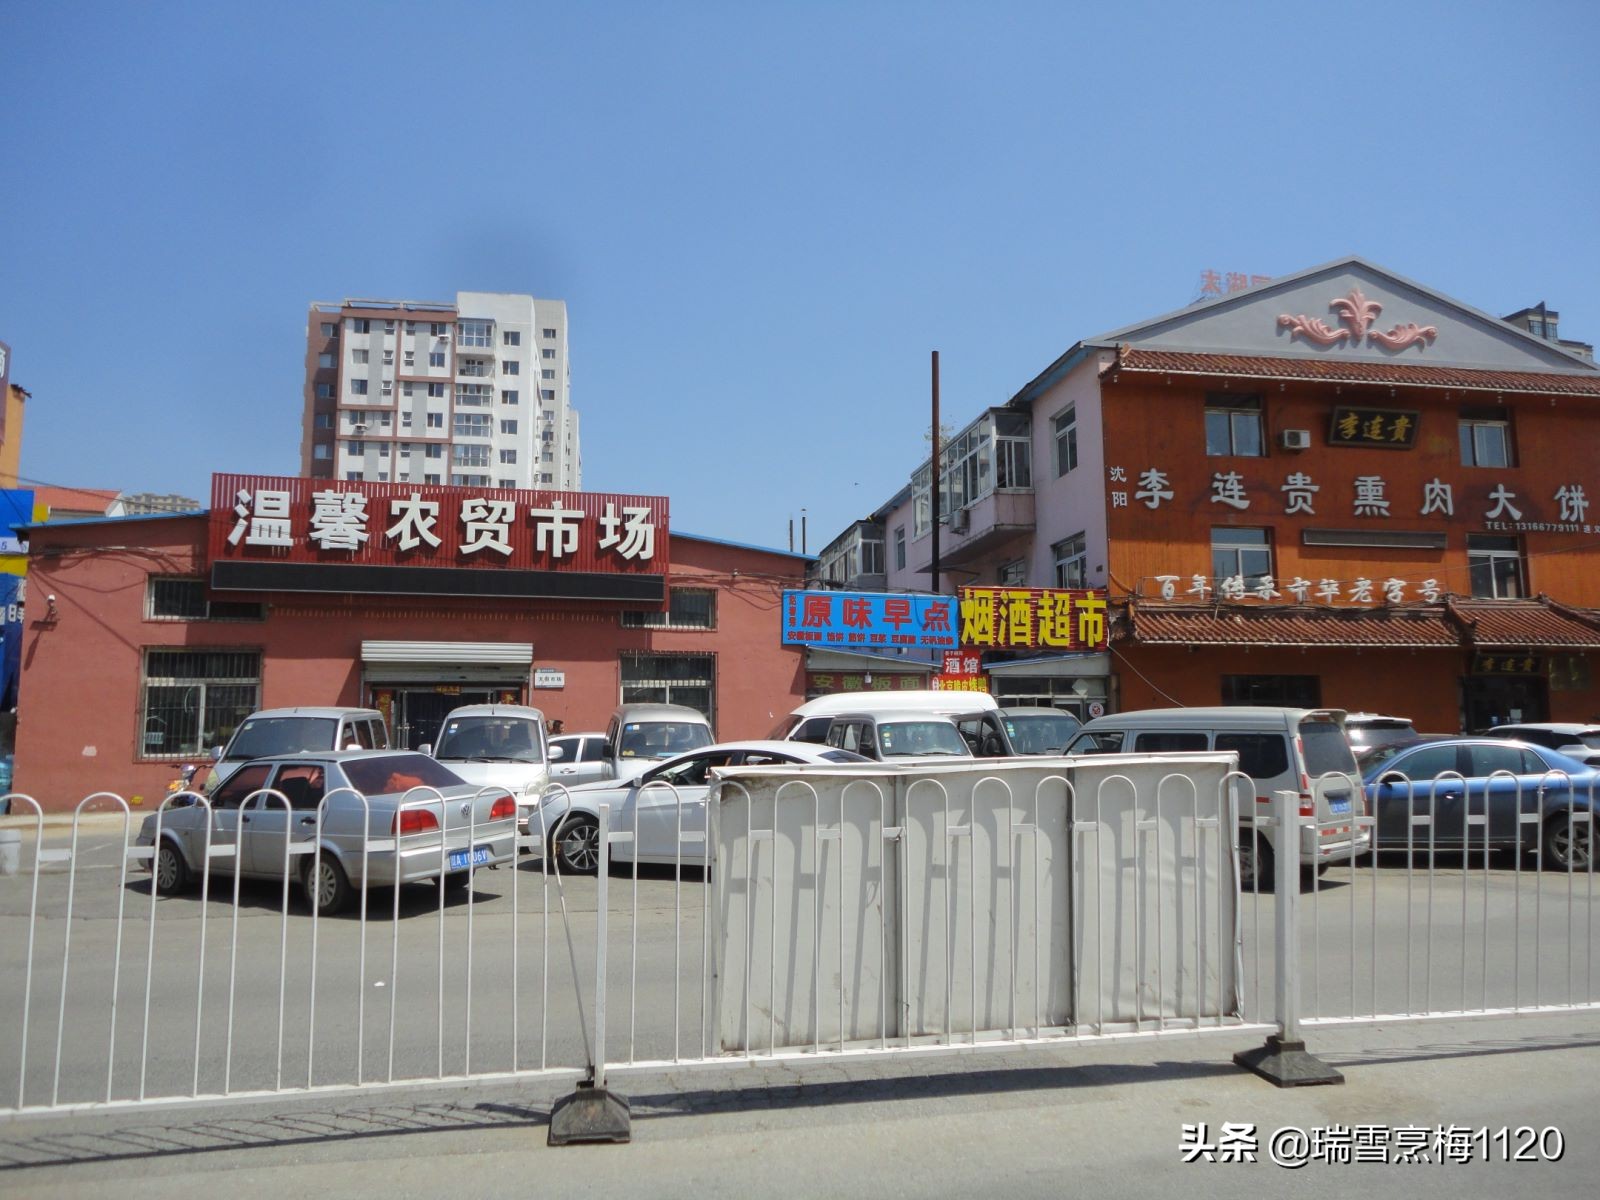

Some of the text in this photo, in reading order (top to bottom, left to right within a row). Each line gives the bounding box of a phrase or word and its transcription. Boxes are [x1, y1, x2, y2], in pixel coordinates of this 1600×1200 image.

[1109, 465, 1128, 509] 沈阳
[1134, 467, 1590, 523] 李连贵熏肉大饼
[228, 488, 656, 561] 温馨农贸市场
[801, 595, 951, 632] 原味早点
[960, 588, 1107, 648] 烟酒超市
[813, 674, 921, 690] 安徽板面
[945, 657, 979, 674] 酒馆
